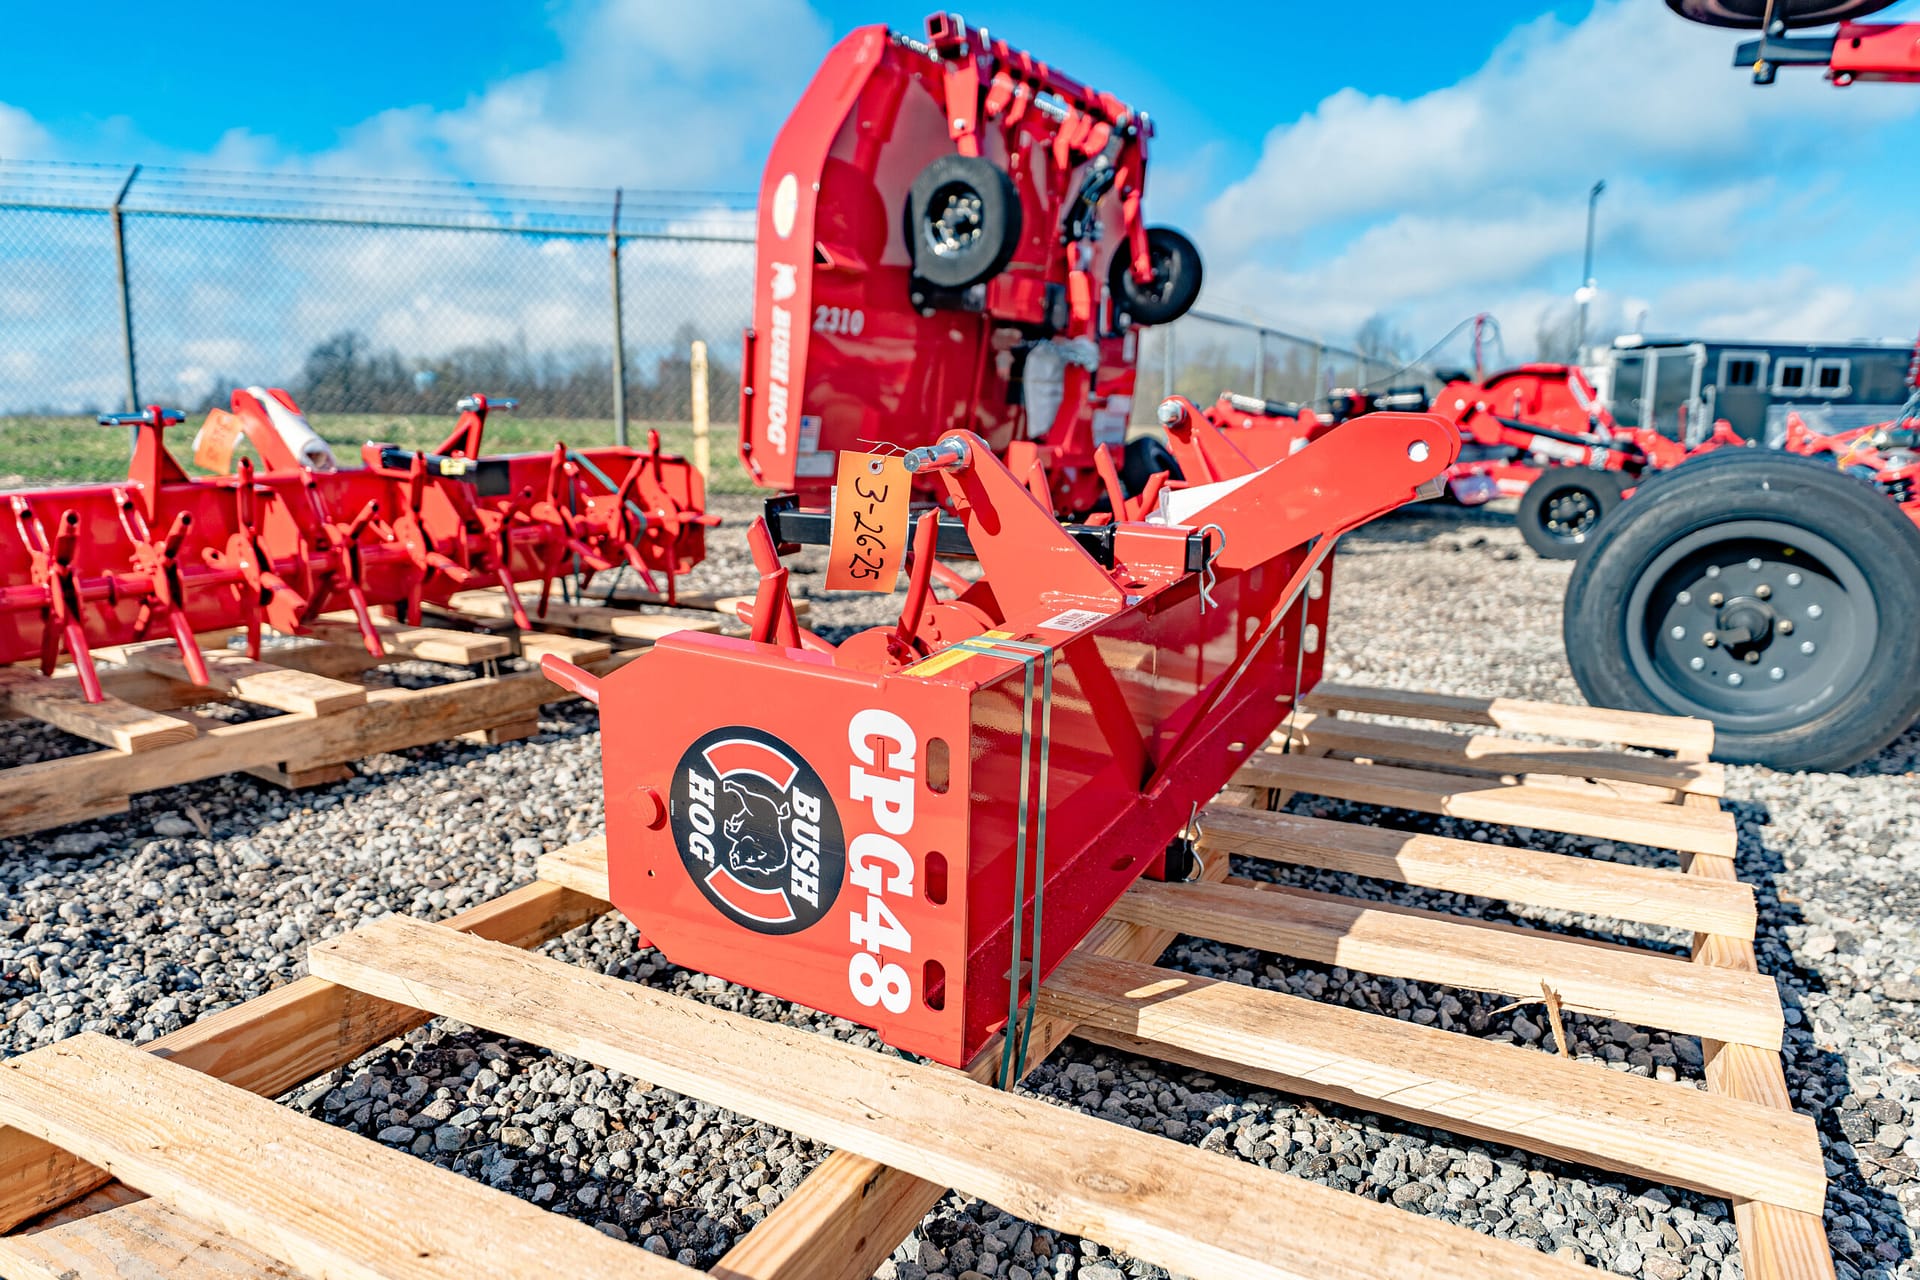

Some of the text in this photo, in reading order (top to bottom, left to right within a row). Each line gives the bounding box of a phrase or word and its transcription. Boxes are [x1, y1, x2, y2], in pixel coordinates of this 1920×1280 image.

[767, 305, 792, 447] BUSH HOG
[813, 305, 865, 336] 2310
[849, 476, 889, 580] 3-26-25
[688, 768, 821, 908] BUSH HOG
[847, 709, 917, 1015] CPG48
